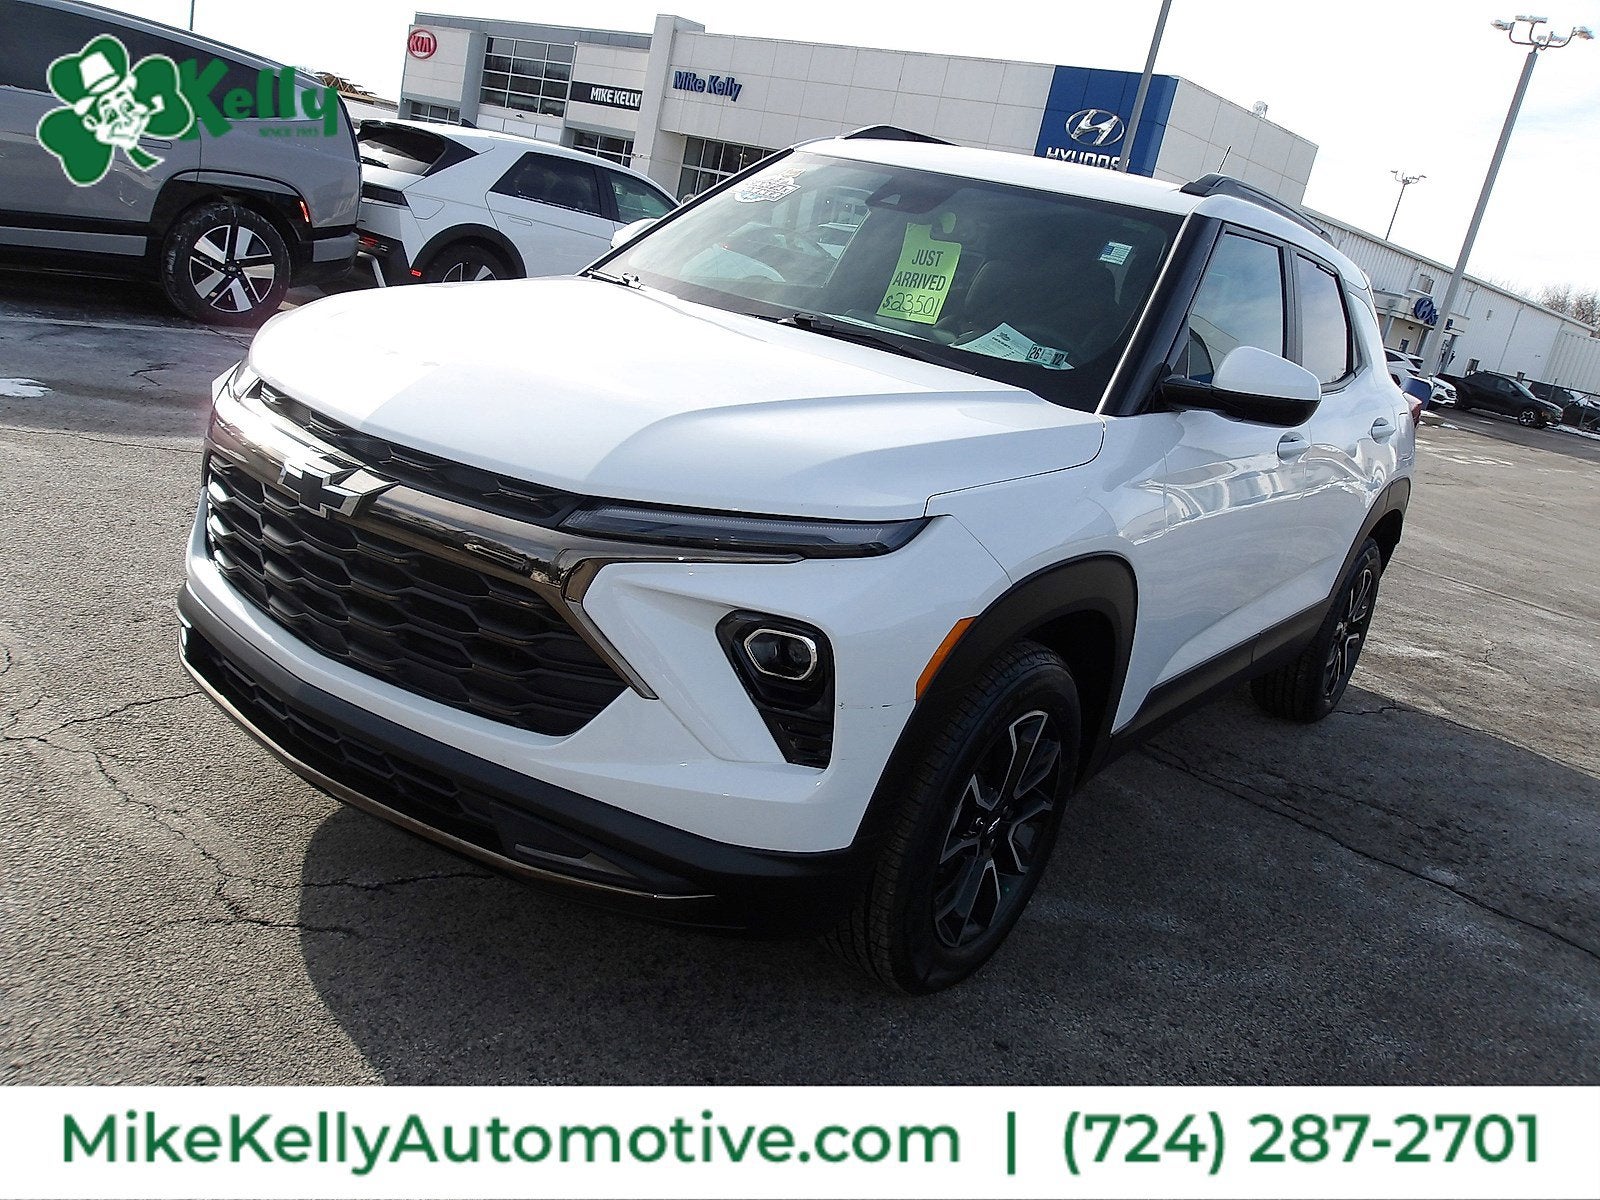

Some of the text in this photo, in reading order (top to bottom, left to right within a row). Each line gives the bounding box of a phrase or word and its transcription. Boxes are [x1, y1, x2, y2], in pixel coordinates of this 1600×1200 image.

[410, 34, 432, 53] KIA
[672, 71, 743, 102] Mike Kelly
[590, 86, 641, 107] MIKE KELLY
[912, 249, 944, 267] JUST
[892, 271, 947, 291] ARRIVED
[1029, 346, 1042, 360] 26
